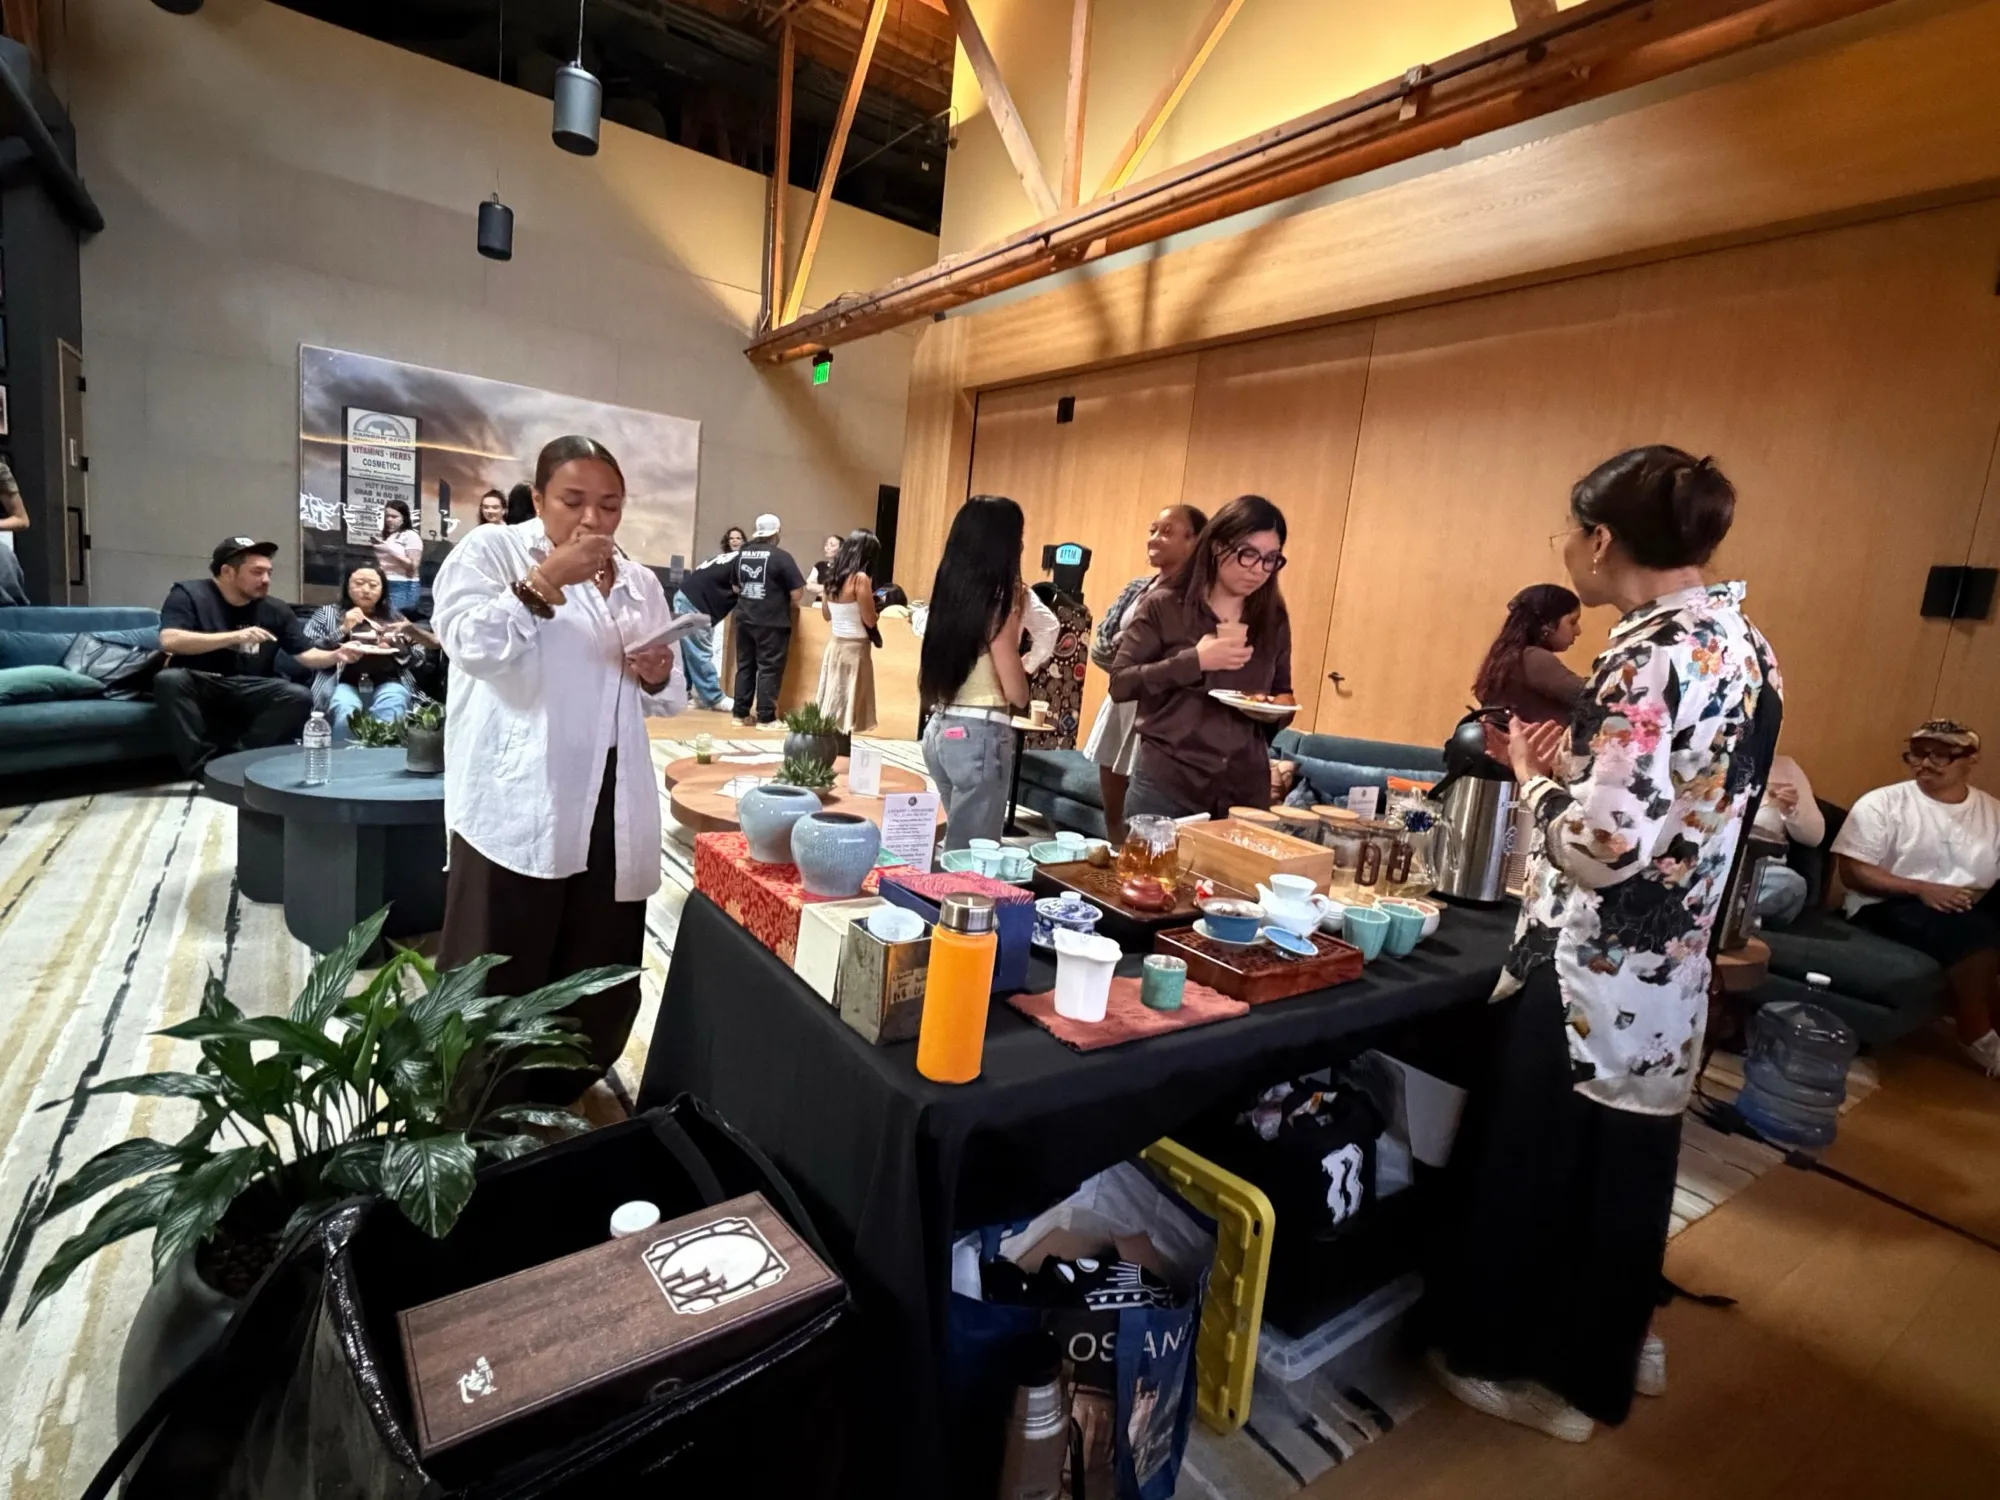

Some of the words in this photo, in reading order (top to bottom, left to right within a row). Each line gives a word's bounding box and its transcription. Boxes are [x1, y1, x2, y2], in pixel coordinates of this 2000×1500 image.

[352, 445, 384, 457] VITAMINS
[389, 451, 412, 461] HERBS
[362, 458, 401, 471] COSMETICS
[741, 550, 770, 558] WANTED
[1048, 1330, 1116, 1362] OS
